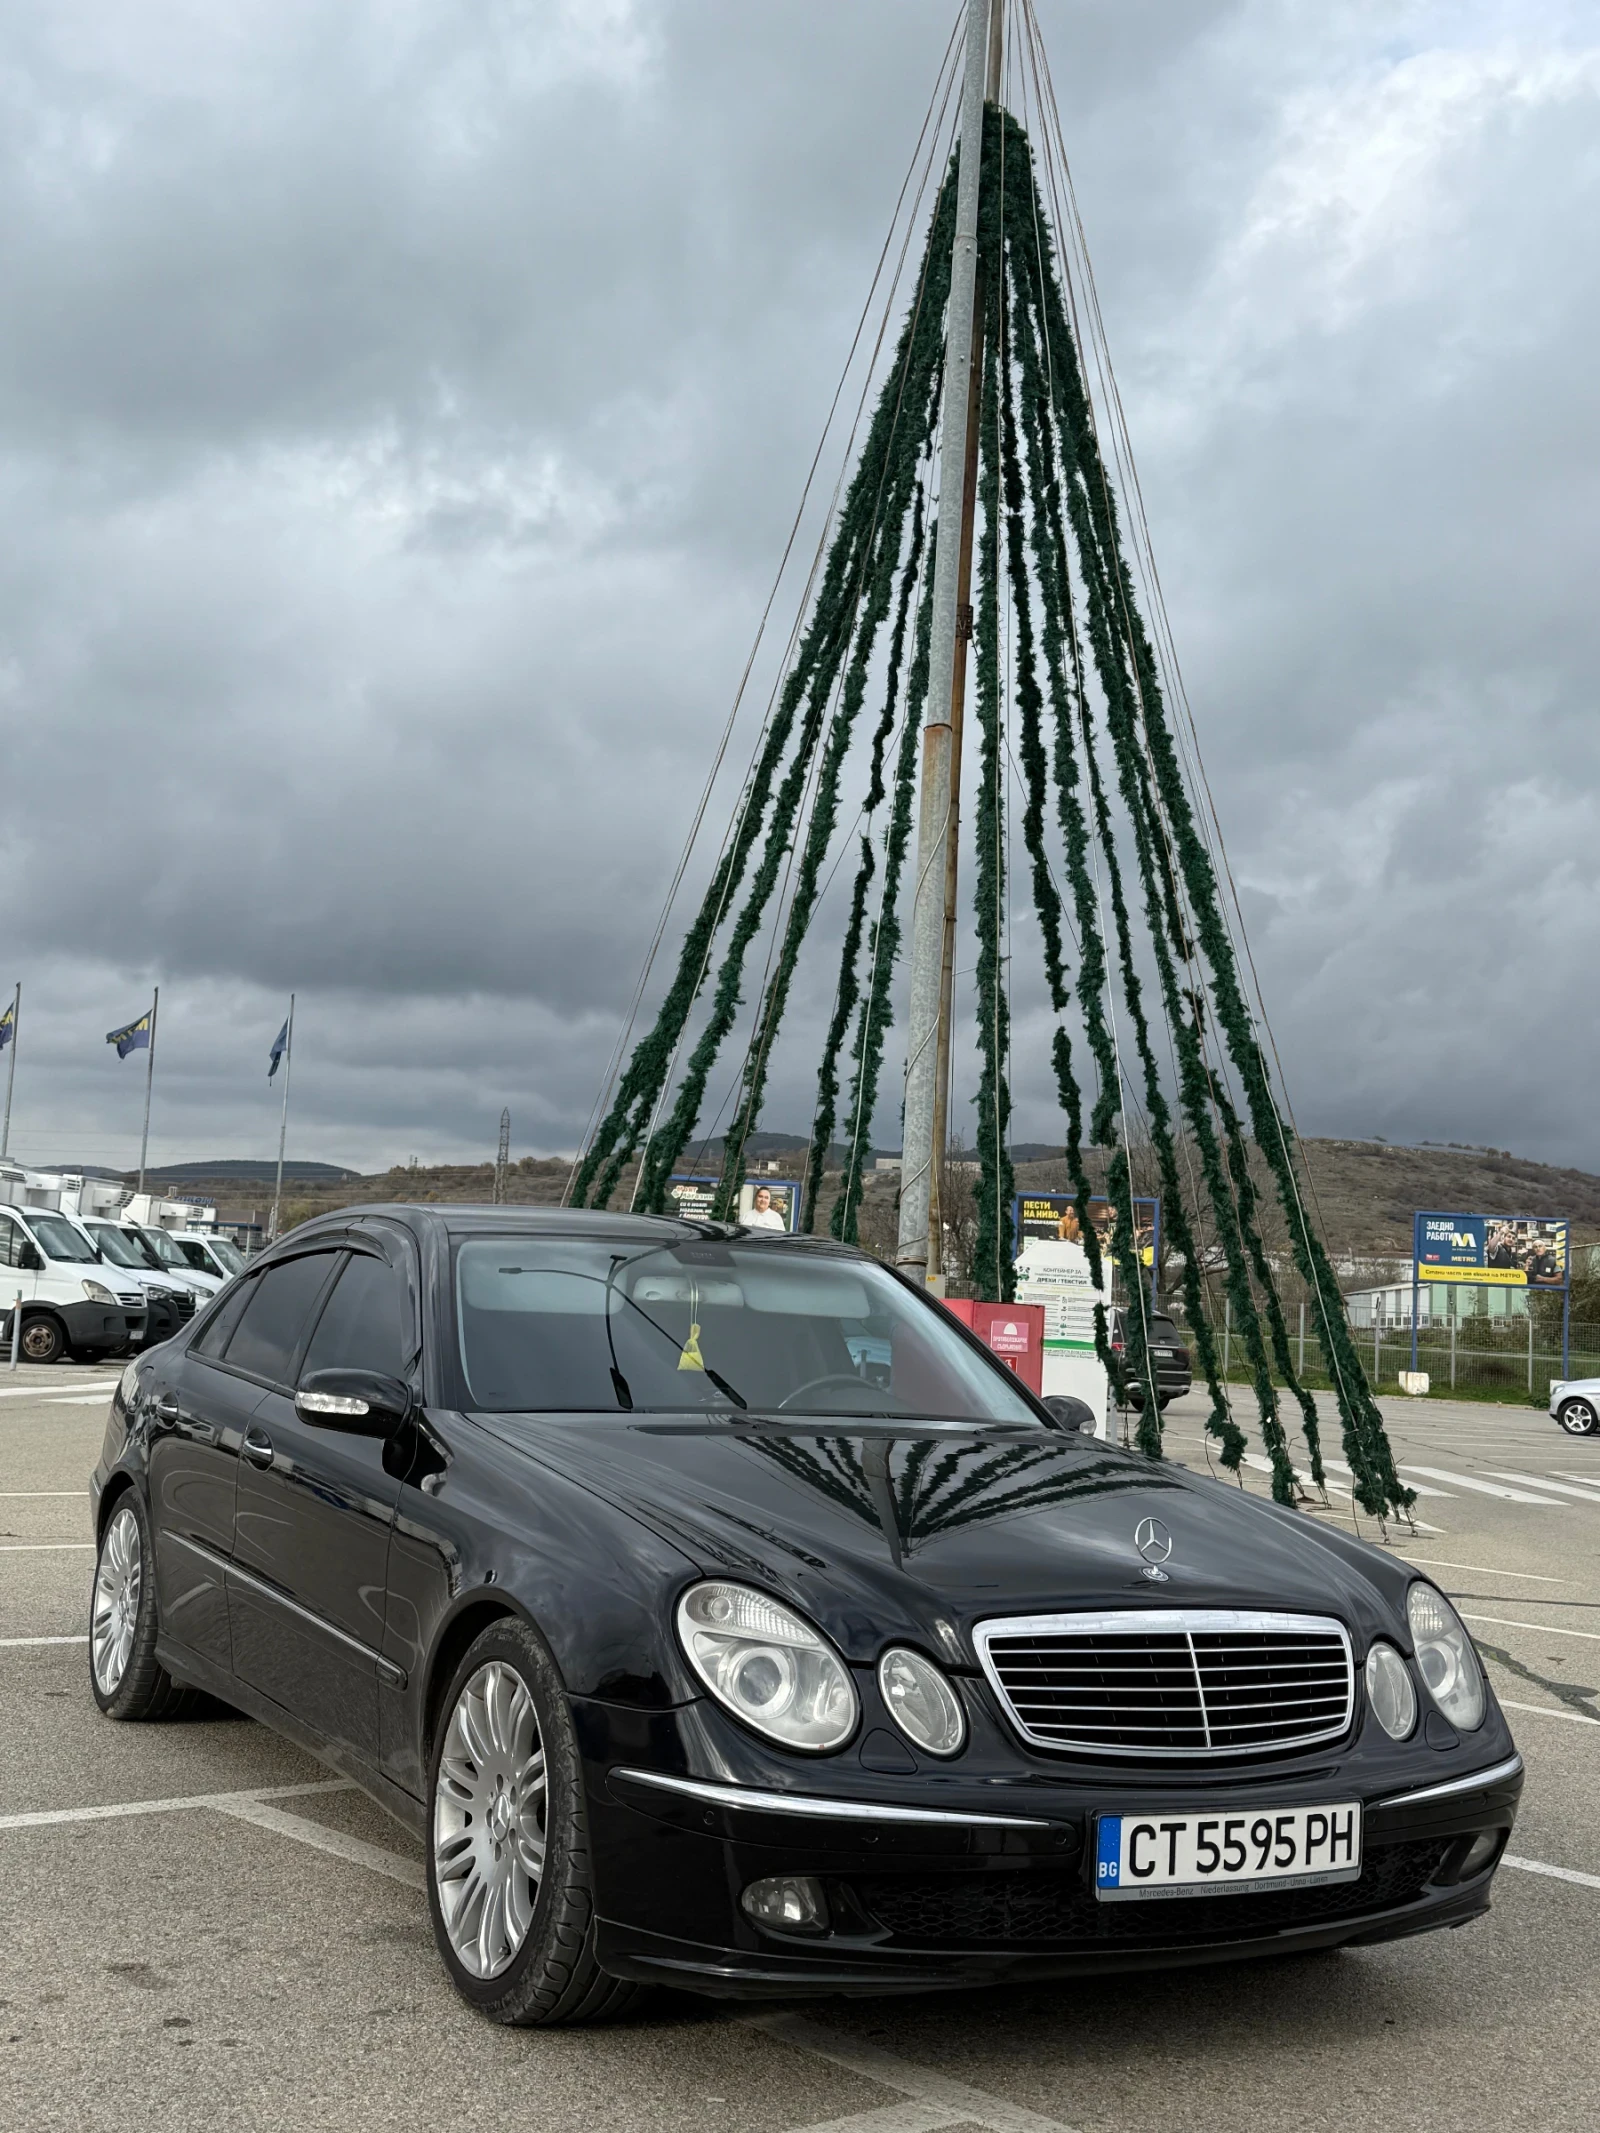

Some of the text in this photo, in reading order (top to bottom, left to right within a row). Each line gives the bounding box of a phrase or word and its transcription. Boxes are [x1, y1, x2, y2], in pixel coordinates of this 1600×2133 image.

[1023, 1201, 1051, 1210] ПЕСТИ
[1023, 1209, 1061, 1219] НА НИВО.
[1426, 1221, 1454, 1231] ЗАЕДНО
[1451, 1255, 1477, 1263] METRO
[1043, 1267, 1074, 1275] КОНТЕЙНЕР
[1128, 1810, 1353, 1878] CT 5595 PH
[1098, 1862, 1118, 1878] BG
[1139, 1886, 1194, 1898] Mercedes-Benz
[1200, 1883, 1249, 1895] Niederlassung
